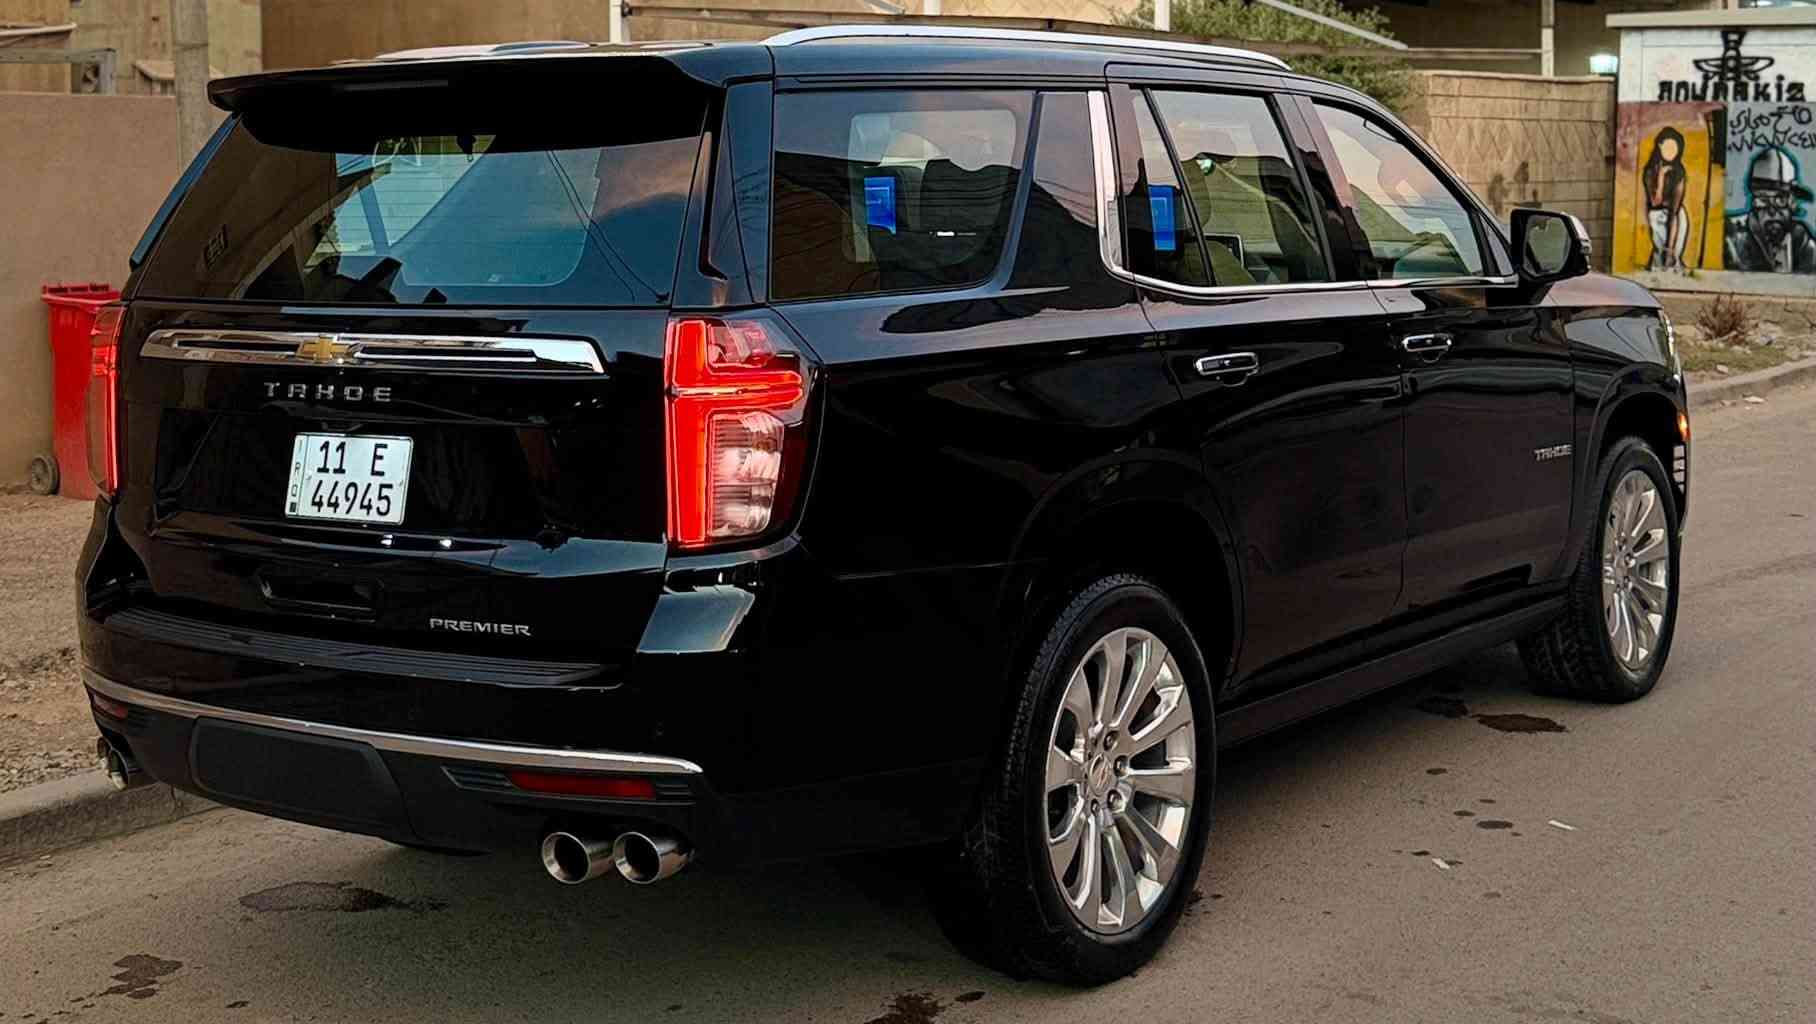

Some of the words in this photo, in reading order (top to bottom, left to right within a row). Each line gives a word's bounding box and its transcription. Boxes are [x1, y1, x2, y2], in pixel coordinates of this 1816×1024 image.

[263, 381, 392, 402] TAHOE
[316, 440, 347, 475] 11
[370, 443, 388, 477] E
[311, 479, 394, 517] 44945
[429, 617, 532, 637] PREMIER
